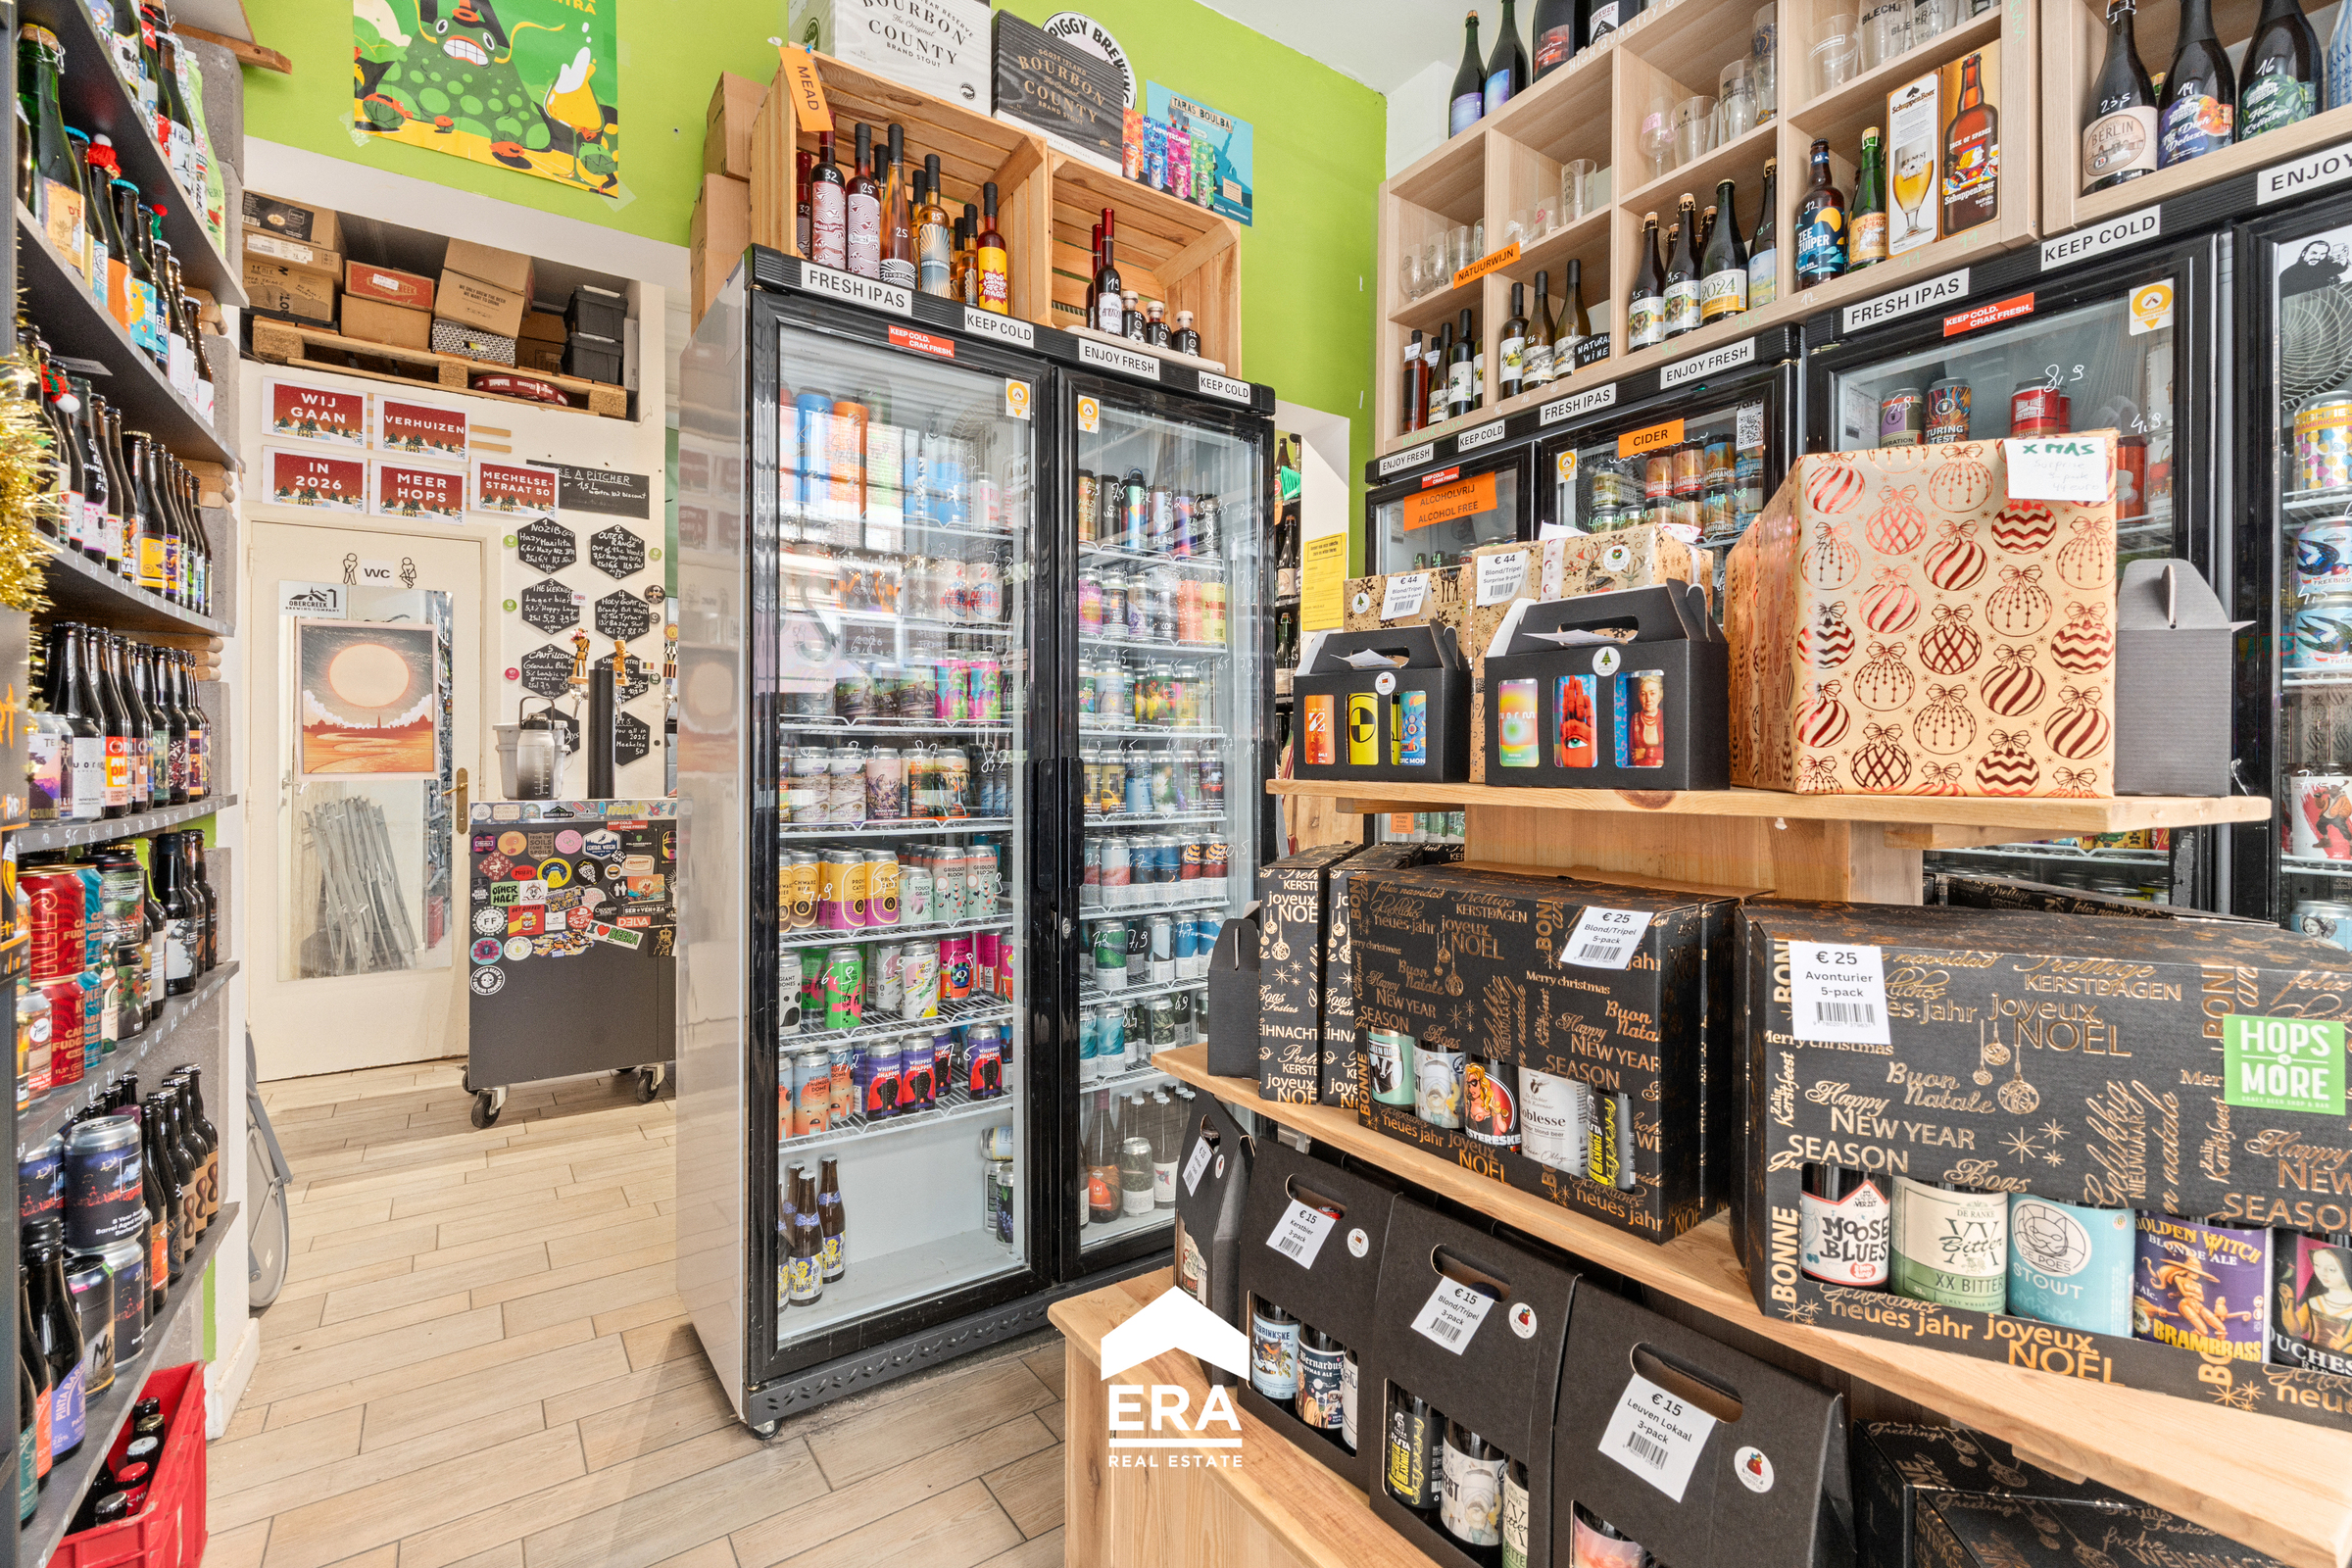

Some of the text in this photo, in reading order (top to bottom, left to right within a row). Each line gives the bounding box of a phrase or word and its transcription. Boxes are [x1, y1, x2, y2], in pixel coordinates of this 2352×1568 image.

[863, 0, 966, 46] BOURBON
[940, 7, 974, 38] RESERVE
[1592, 5, 1616, 24] GUEUZE
[905, 21, 936, 38] Original
[1048, 19, 1088, 37] PIGGY
[1569, 4, 1659, 72] HIGH QUALITY
[868, 20, 956, 66] COUNTY
[886, 42, 941, 68] BRAND STOUT
[1039, 49, 1087, 76] GOOSE ISLAND
[2256, 57, 2275, 75] 16
[797, 66, 819, 111] MEAD
[1017, 56, 1105, 106] BOURBON
[1055, 79, 1079, 97] Original
[1024, 80, 1098, 123] COUNTY
[1038, 101, 1083, 125] BRAND STOUT
[1172, 97, 1230, 129] TARAS BOULBA
[1949, 139, 1962, 150] JACK
[1972, 126, 1991, 140] SPADES
[2091, 120, 2133, 146] BERLIN
[824, 170, 838, 183] 32
[860, 183, 875, 194] 25
[1944, 180, 1994, 205] SchuppenBoer
[896, 227, 908, 237] 25
[1798, 226, 1813, 243] ZEE
[2044, 216, 2156, 263] KEEP COLD
[1798, 234, 1830, 255] ZUIPER
[1457, 249, 1514, 281] NATUURWIJN
[809, 270, 906, 307] FRESH IPAS
[1107, 277, 1120, 291] 19
[1701, 278, 1737, 301] 2024
[1851, 277, 1960, 325] FRESH IPAS
[1946, 306, 1998, 327] KEEP COLD.
[1970, 305, 2032, 328] CRAK FRESH.
[890, 327, 930, 343] KEEP COLD.
[965, 314, 1033, 343] KEEP COLD
[909, 340, 954, 356] CRAK FRESH.
[1085, 346, 1154, 373] ENJOY FRESH
[1666, 346, 1748, 381] ENJOY FRESH
[1200, 376, 1250, 398] KEEP COLD
[300, 392, 337, 408] WIJ
[1544, 389, 1610, 420] FRESH IPAS
[290, 407, 346, 423] GAAN
[384, 415, 465, 435] VERHUIZEN
[1459, 425, 1503, 447] KEEP COLD
[1633, 429, 1668, 447] CIDER
[1926, 423, 1964, 439] TURING
[1938, 433, 1958, 443] TEST
[309, 463, 329, 474] IN
[1382, 449, 1430, 471] ENJOY FRESH
[295, 475, 343, 490] 2026
[397, 472, 447, 489] MEER
[483, 471, 554, 487] MECHELSE-
[486, 481, 550, 497] STRAAT 50
[397, 487, 447, 503] HOPS
[1419, 484, 1475, 507] ALCOHOLVRIJ
[1418, 501, 1478, 524] ALCOHOL FREE
[365, 567, 391, 578] WC
[1485, 565, 1522, 576] Blond/Tripel
[1392, 585, 1422, 594] Blond/Tripel
[289, 600, 327, 609] OBERCREEK
[608, 802, 645, 815] mash
[492, 885, 517, 895] OTHER
[493, 895, 518, 904] HALF
[1602, 913, 1632, 924] € 25
[609, 927, 639, 946] BEERA
[1584, 924, 1637, 936] Blond/Tripel
[1592, 935, 1621, 945] 5-pack
[1815, 951, 1858, 966] € 25
[1805, 970, 1874, 983] Avonturier
[1821, 986, 1864, 998] 5-pack
[2023, 972, 2183, 1003] KERSTDAGEN
[2240, 1019, 2330, 1056] HOPS
[876, 1064, 901, 1073] WHIPPER
[1886, 1060, 1960, 1090] Buon
[2240, 1062, 2330, 1101] MORE
[1805, 1080, 1889, 1117] Happy
[1831, 1106, 1976, 1151] NEW YEAR
[1788, 1134, 1909, 1174] SEASON
[119, 1213, 132, 1222] Year
[1298, 1210, 1318, 1224] € 15
[1968, 1209, 1995, 1219] RANKE
[95, 1220, 134, 1235] Barrel Aged
[1288, 1229, 1307, 1243] 3-pack
[1290, 1219, 1314, 1236] Kerstbier
[1822, 1215, 1889, 1243] MOOSE
[1771, 1205, 1799, 1303] BONNE
[1819, 1238, 1887, 1263] BLUES
[1938, 1235, 2003, 1257] Bitter
[2148, 1233, 2238, 1266] BLONDE ALE
[2201, 1230, 2262, 1264] WITCH
[2020, 1245, 2073, 1274] DE POES
[1935, 1273, 2004, 1294] XX BITTER
[1454, 1287, 1479, 1305] € 15
[1438, 1295, 1480, 1322] Blond/Tripel
[1441, 1308, 1465, 1327] 3-pack
[1831, 1299, 1974, 1341] neues jahr
[1983, 1313, 2100, 1357] joyeux
[1299, 1349, 1343, 1370] Bernardus
[54, 1391, 70, 1423] PINTA
[1651, 1393, 1684, 1417] € 15
[1627, 1398, 1692, 1443] Leuven Lokaal
[1638, 1420, 1669, 1445] 3-pack
